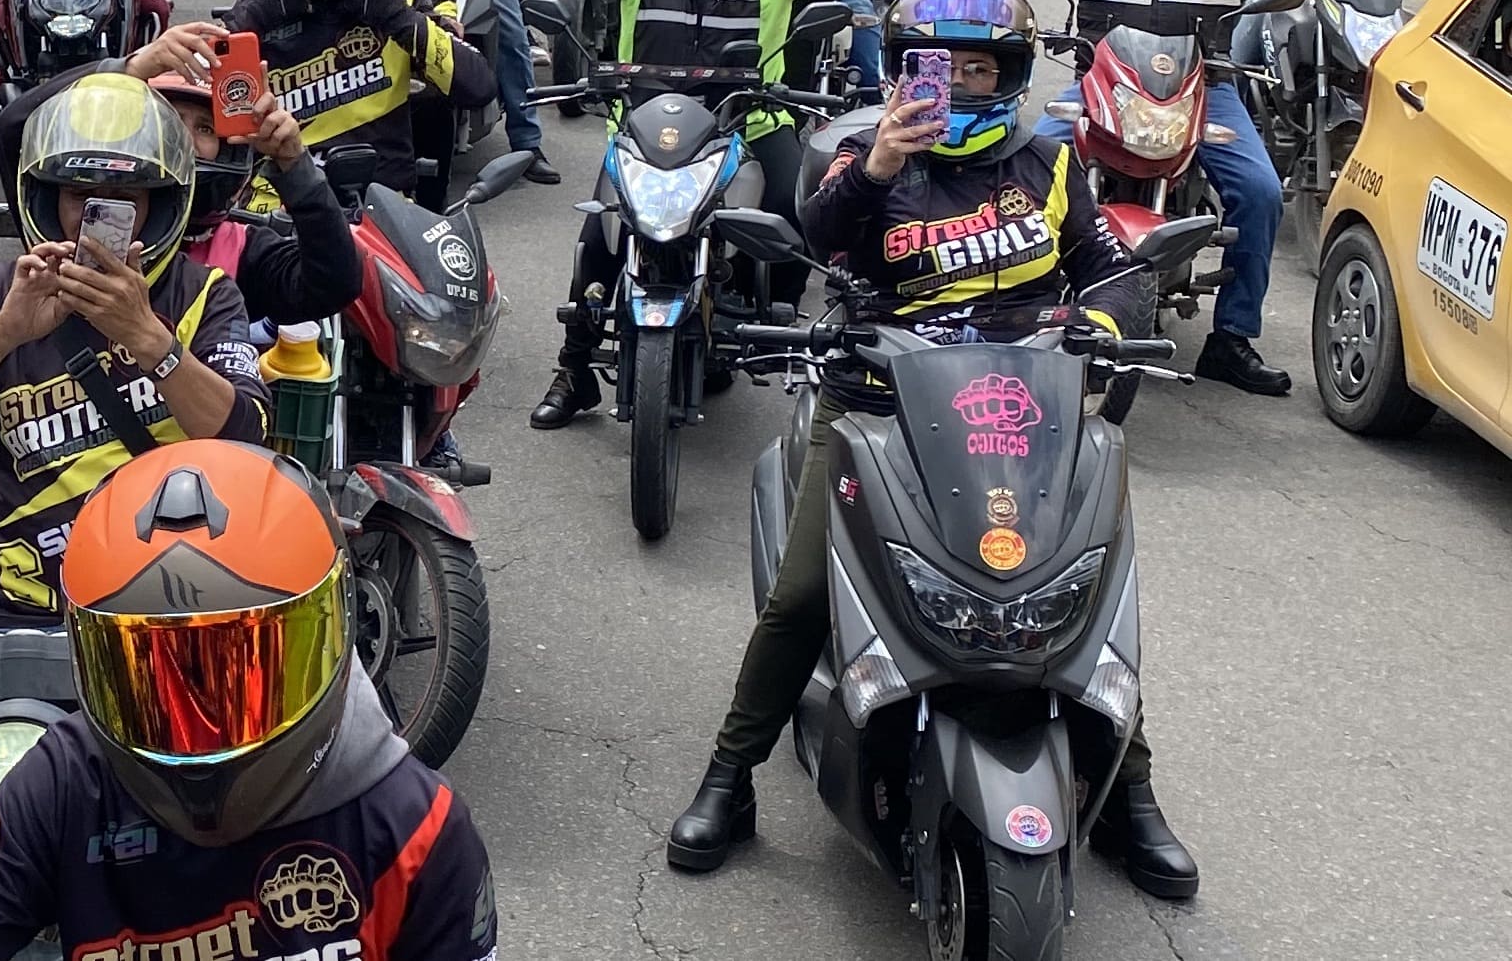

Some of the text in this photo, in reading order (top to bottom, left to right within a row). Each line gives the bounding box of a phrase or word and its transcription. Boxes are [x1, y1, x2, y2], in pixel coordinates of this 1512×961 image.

[270, 49, 338, 96] treet
[276, 56, 386, 115] OTHERS
[422, 219, 452, 244] GAZU
[885, 202, 999, 261] Street
[937, 212, 1051, 273] GIRLS
[1422, 191, 1502, 296] WPM 376
[1433, 262, 1462, 293] BOGOTA
[0, 380, 89, 432] Stree
[967, 432, 1029, 458] OJITOS
